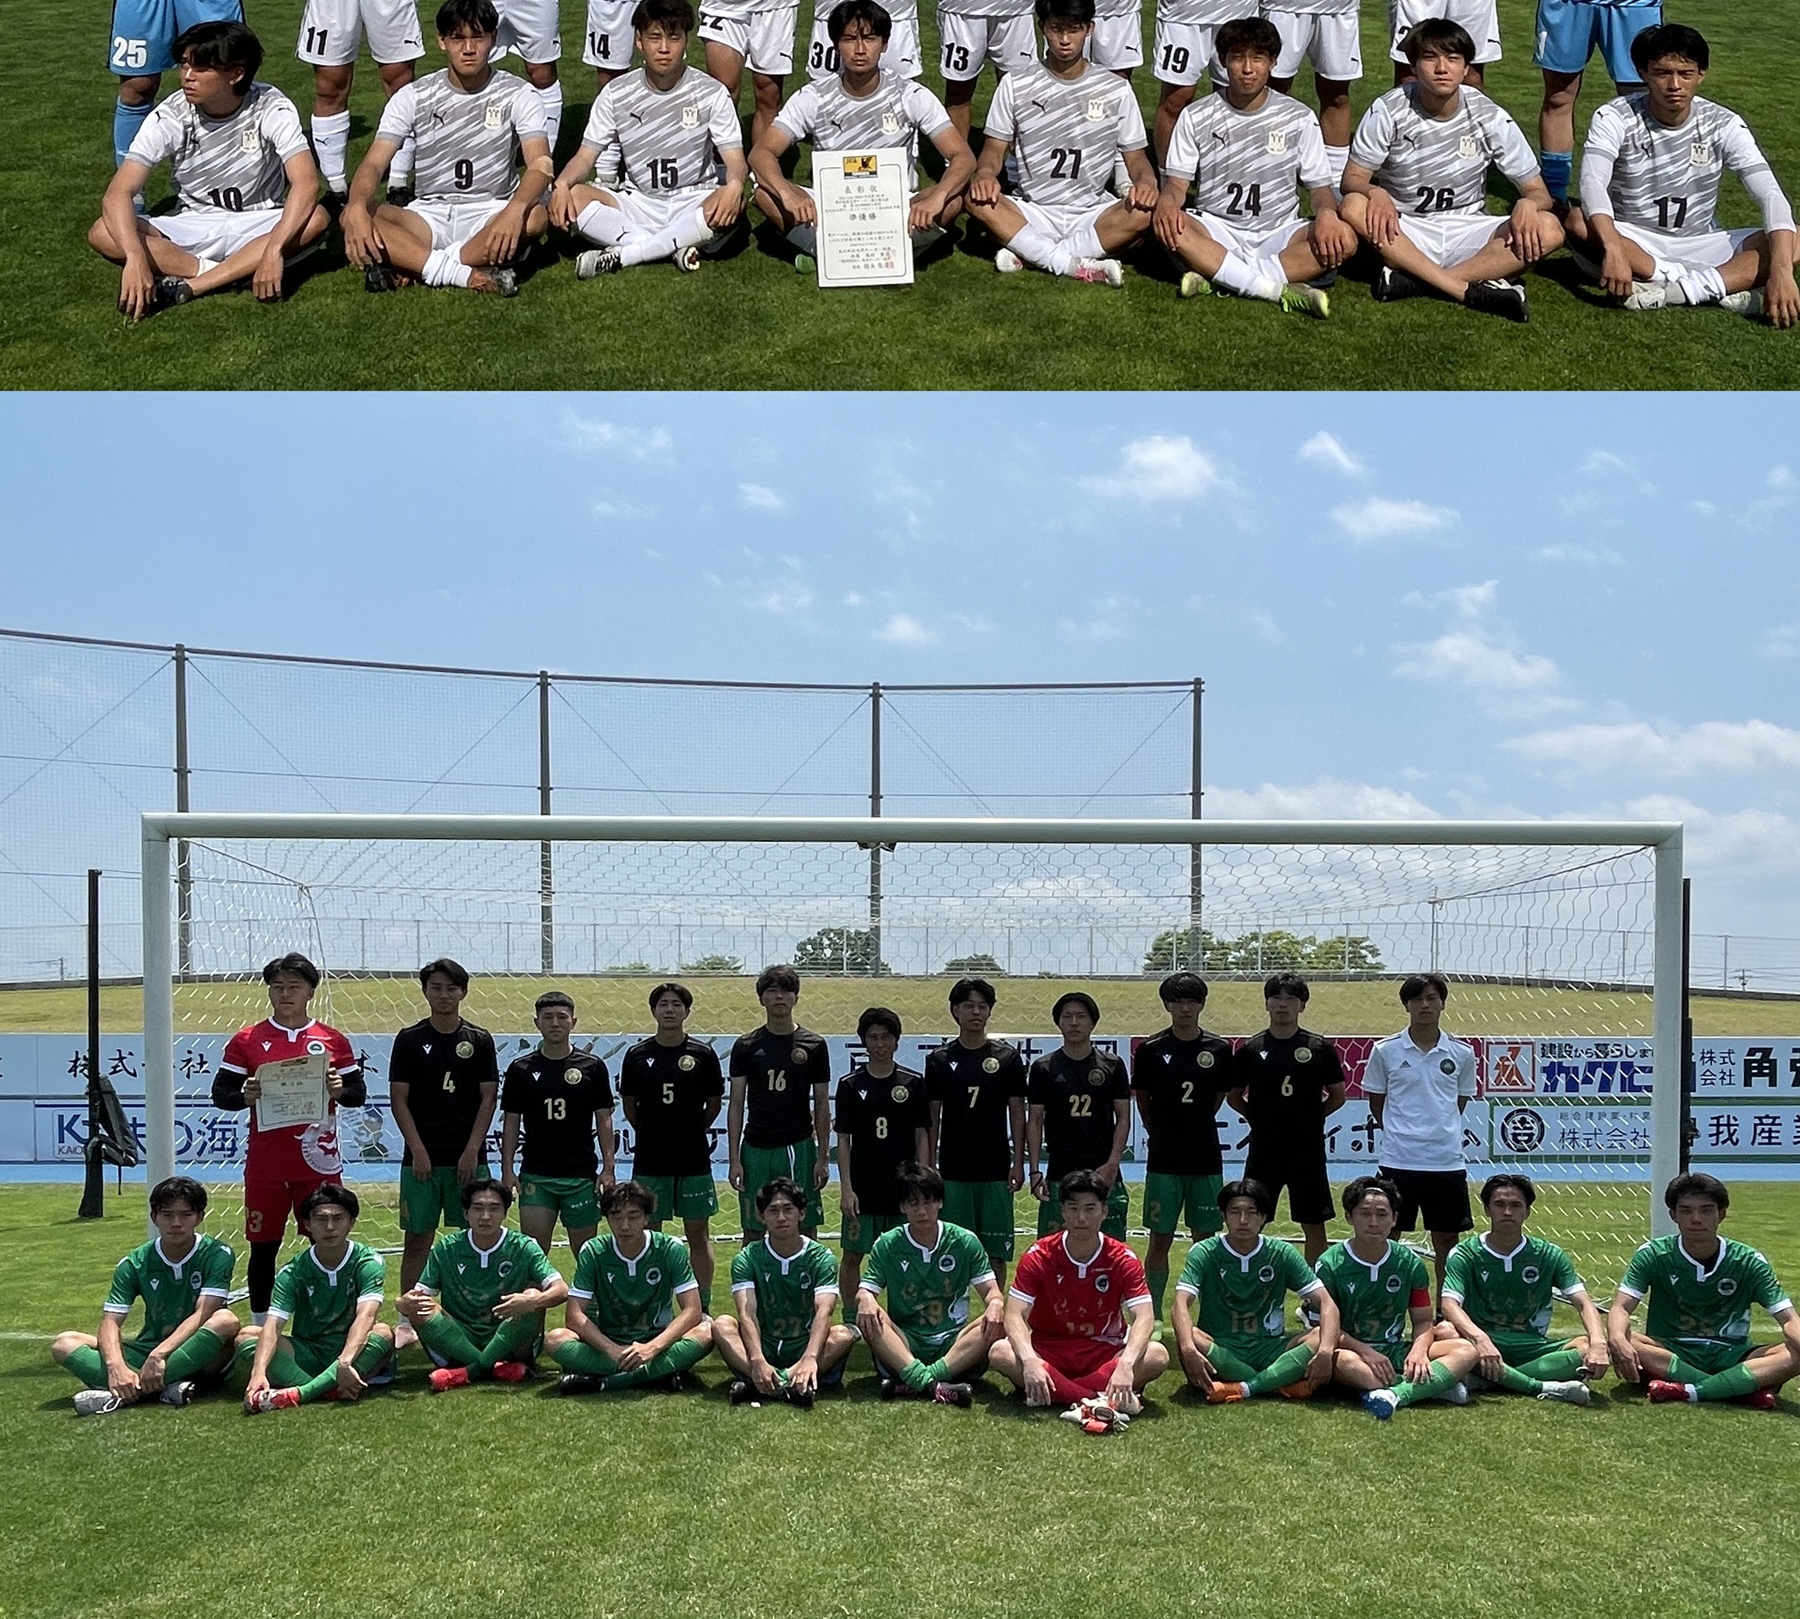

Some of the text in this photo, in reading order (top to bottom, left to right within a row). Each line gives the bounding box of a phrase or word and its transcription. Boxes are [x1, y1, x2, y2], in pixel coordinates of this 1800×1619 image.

[112, 36, 148, 68] 25
[306, 25, 327, 57] 11
[588, 31, 612, 60] 14
[810, 40, 841, 72] 30
[944, 41, 970, 72] 13
[1162, 43, 1191, 75] 19
[454, 158, 474, 189] 9
[646, 158, 678, 189] 15
[1050, 148, 1083, 180] 27
[1226, 183, 1262, 217] 24
[1415, 186, 1456, 215] 26
[1653, 196, 1689, 229] 17
[1700, 1048, 1736, 1068] 株式
[442, 1071, 456, 1094] 4
[767, 1069, 788, 1092] 16
[1281, 1075, 1294, 1097] 6
[1700, 1069, 1736, 1088] 会社
[662, 1083, 675, 1105] 5
[967, 1086, 980, 1109] 7
[1069, 1094, 1093, 1117] 22
[1181, 1081, 1195, 1104] 2
[543, 1098, 567, 1121] 13
[875, 1117, 889, 1139] 8
[1558, 1127, 1651, 1151] 株式会社
